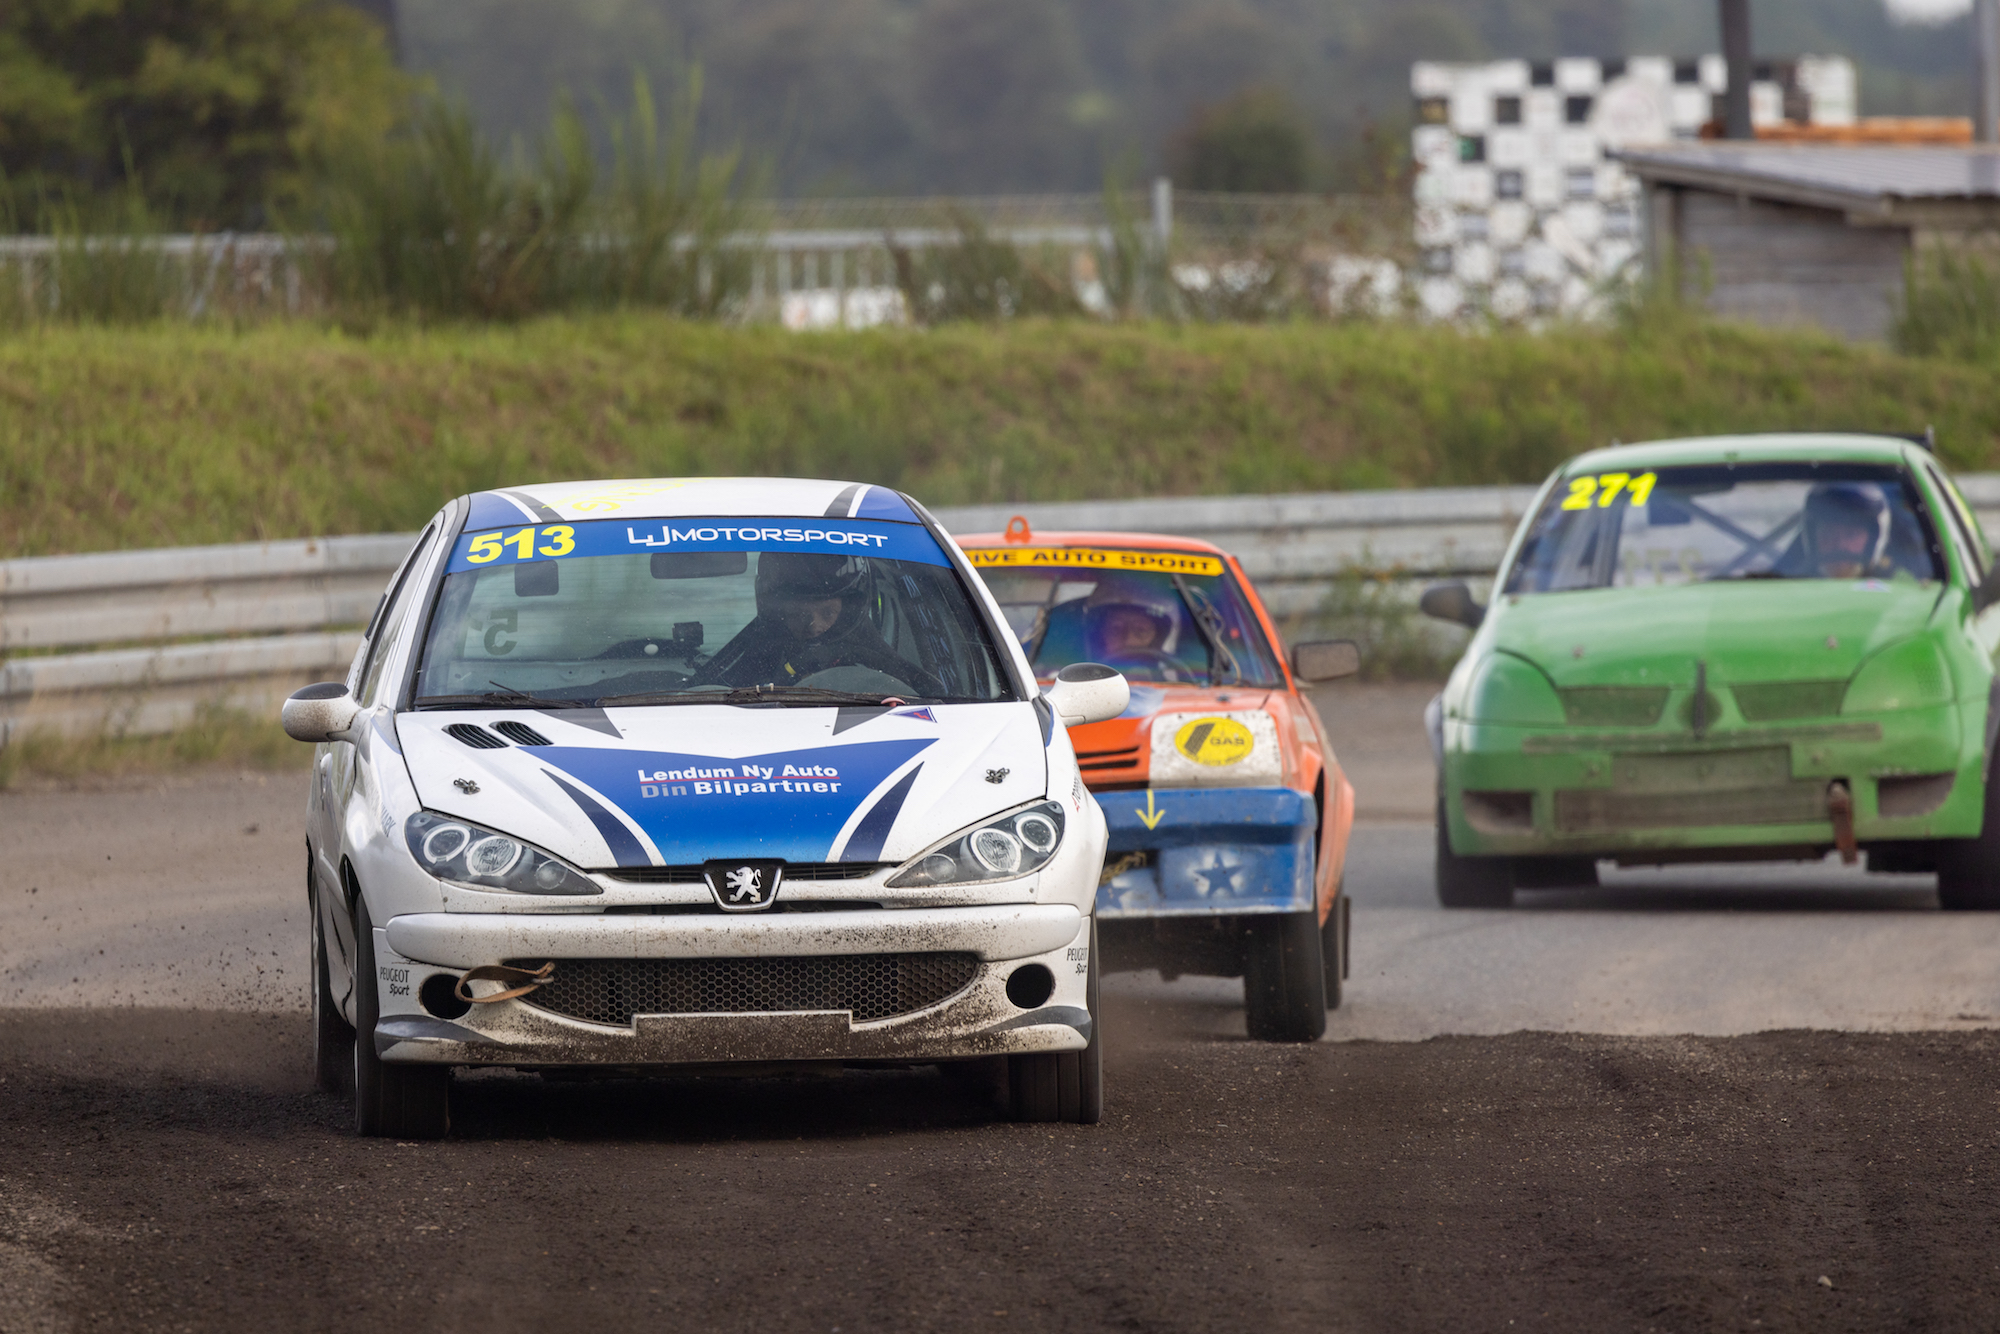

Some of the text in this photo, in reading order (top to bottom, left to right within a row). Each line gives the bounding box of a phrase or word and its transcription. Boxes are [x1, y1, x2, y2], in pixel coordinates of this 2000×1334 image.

[1561, 472, 1658, 511] 271
[466, 525, 576, 564] 513
[969, 551, 1212, 571] IVE AUTO SPORT
[1209, 736, 1245, 746] GAS
[637, 764, 838, 782] Lendum Ny Auto
[640, 780, 842, 799] Din Bilpartner
[380, 966, 410, 983] PEUGEOT
[389, 983, 410, 997] Sport
